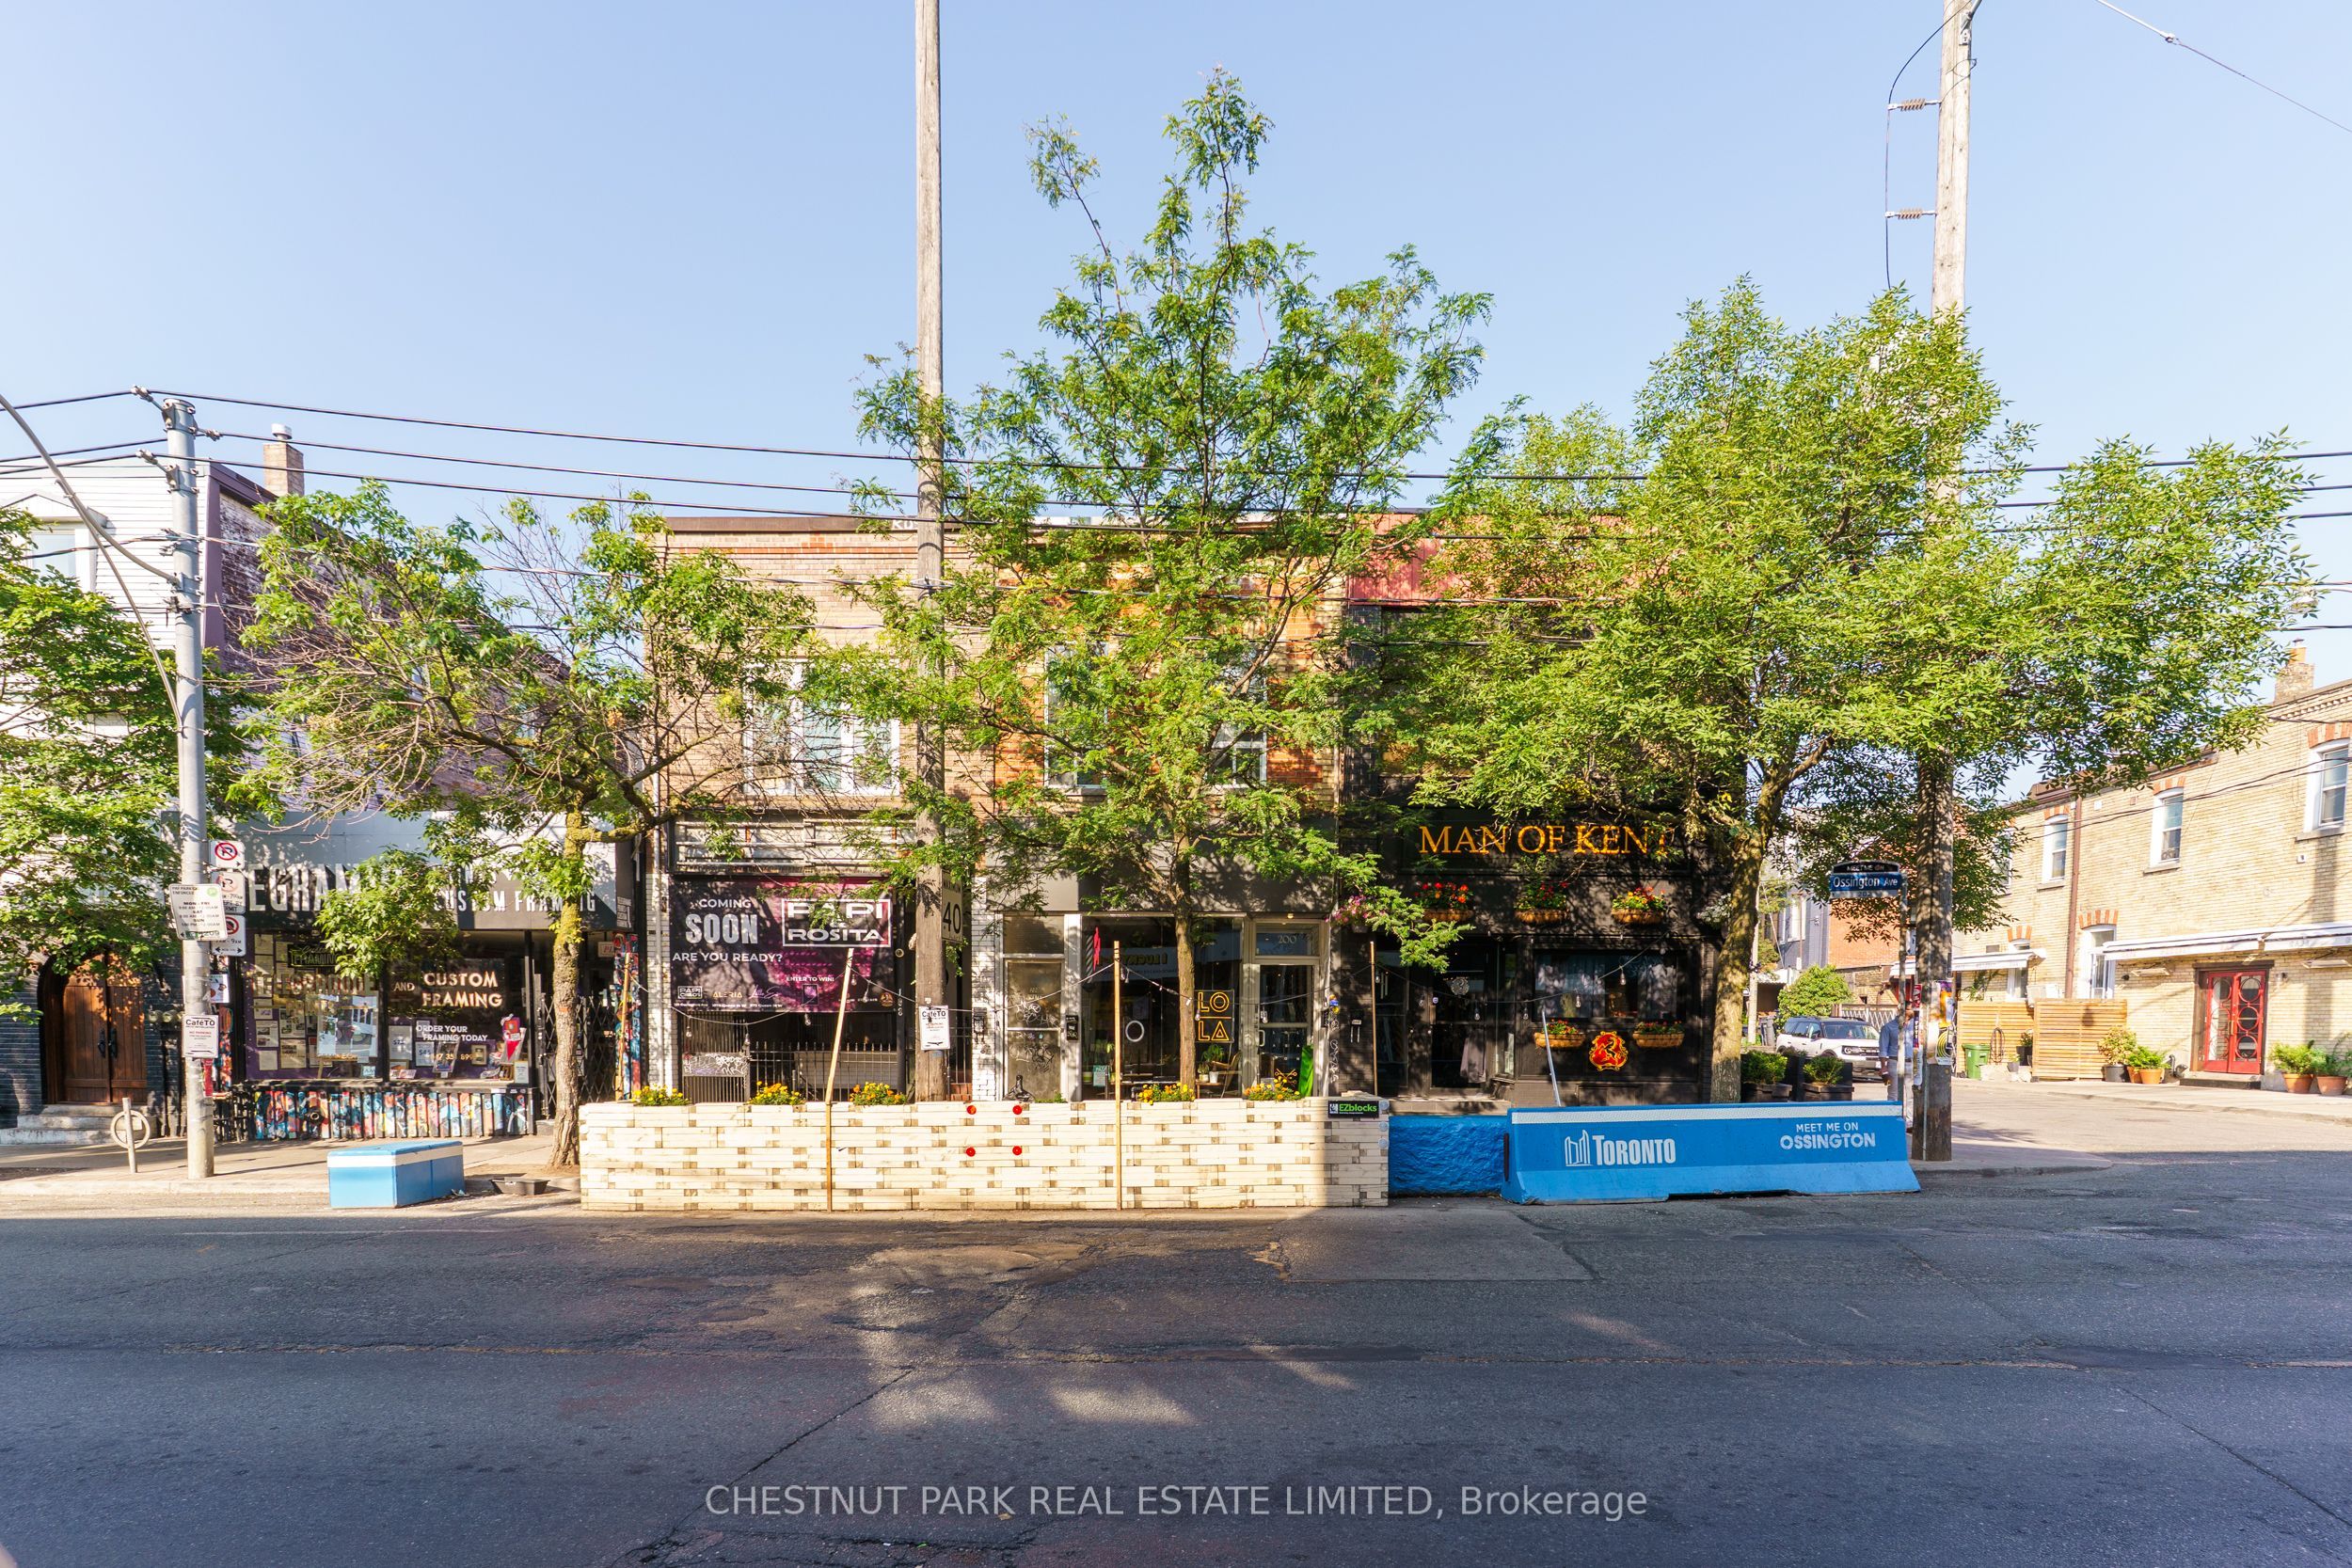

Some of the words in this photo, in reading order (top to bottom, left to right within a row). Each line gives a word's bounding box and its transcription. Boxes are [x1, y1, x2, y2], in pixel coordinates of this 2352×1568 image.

[1419, 826, 1505, 854] MAN
[1518, 825, 1565, 854] OF
[1574, 825, 1675, 855] KENT
[1833, 877, 1880, 889] Ossington
[1884, 878, 1899, 886] Ave
[699, 898, 752, 909] COMING
[943, 902, 961, 934] 40
[685, 913, 758, 944] SOON
[788, 928, 884, 942] ROSITA
[1278, 935, 1297, 943] 200
[672, 953, 697, 961] ARE
[701, 953, 728, 961] YOU
[732, 953, 783, 962] READY?
[393, 982, 415, 991] AND
[423, 971, 499, 988] CUSTOM
[422, 991, 503, 1009] FRAMING
[1198, 991, 1230, 1013] LO
[422, 1034, 460, 1042] FRAMING
[1198, 1021, 1230, 1041] LA
[1339, 1103, 1377, 1112] EZblocks
[1795, 1122, 1823, 1132] MEET
[1826, 1122, 1842, 1132] ME
[1843, 1121, 1859, 1132] ON
[1779, 1132, 1876, 1150] OSSINGTON
[1592, 1134, 1677, 1166] TORONTO
